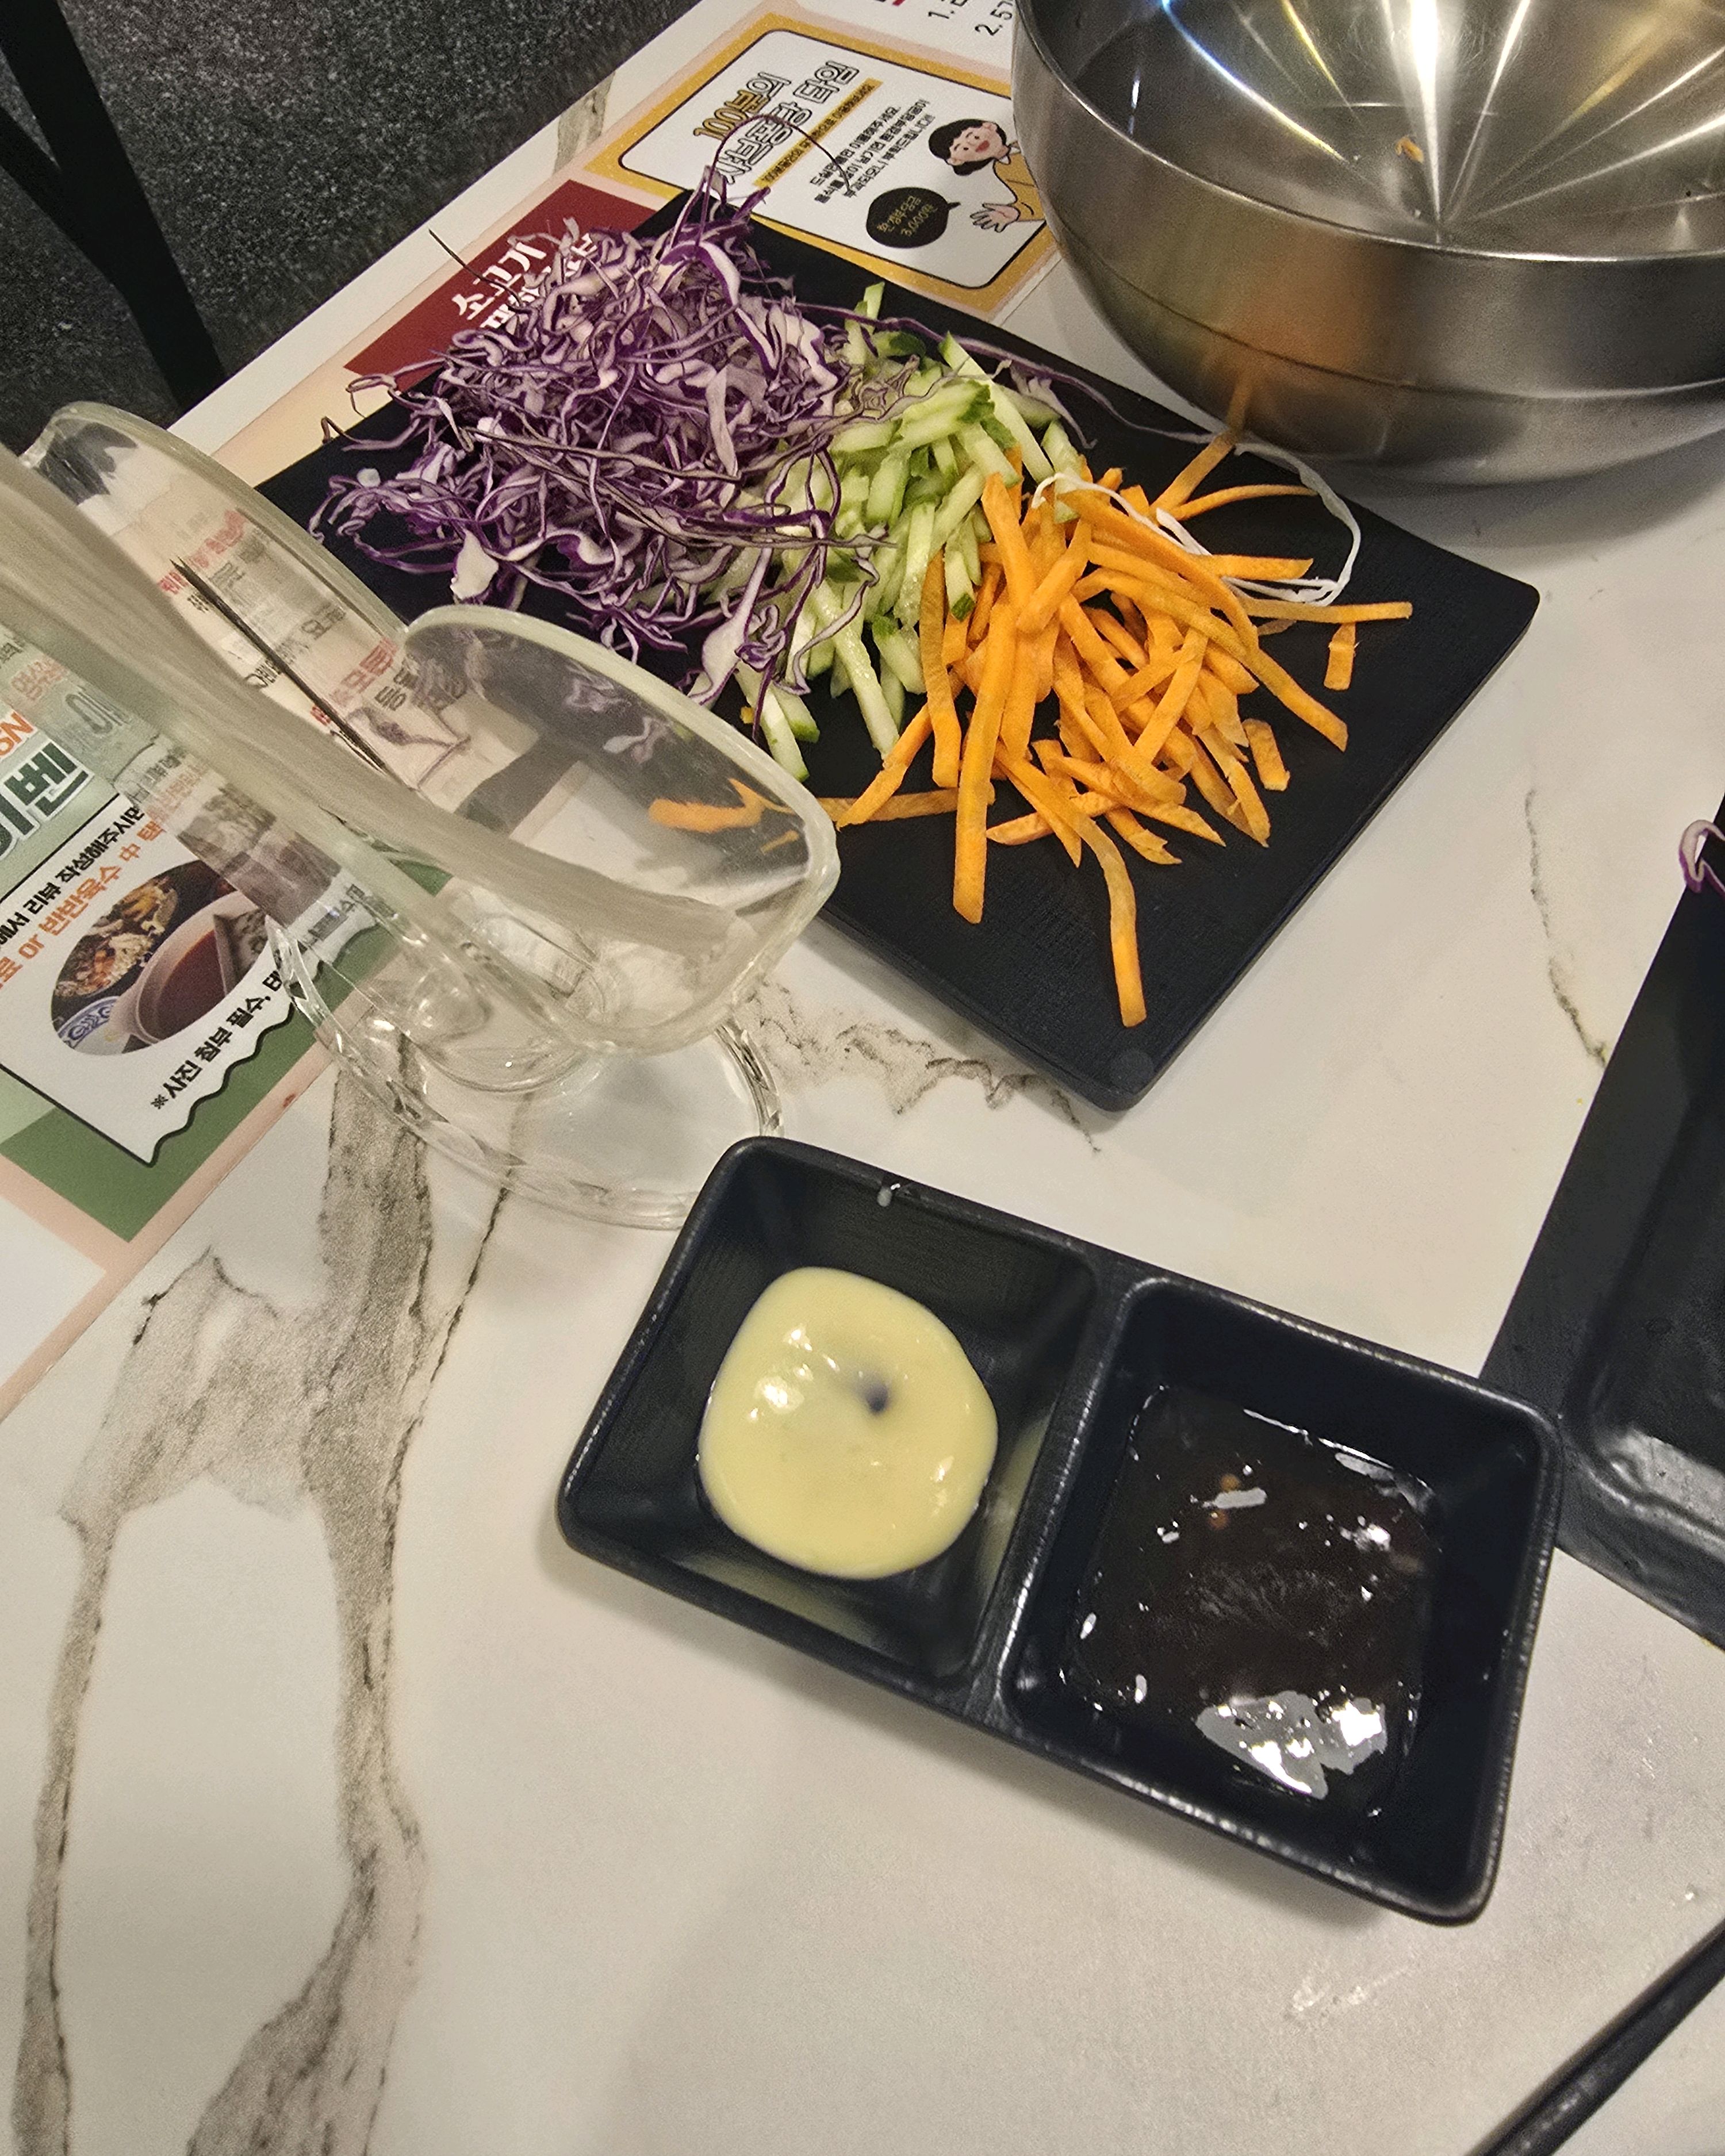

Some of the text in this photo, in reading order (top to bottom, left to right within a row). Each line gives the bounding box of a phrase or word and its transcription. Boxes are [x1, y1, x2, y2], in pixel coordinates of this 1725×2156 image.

[693, 71, 792, 141] 100분의
[716, 60, 860, 185] 샤브퐁당 타임
[451, 241, 547, 320] 소고기
[23, 882, 62, 914] 리뷰
[39, 865, 122, 935] 반반육수
[119, 843, 141, 861] 中
[194, 1026, 232, 1062] 첨부
